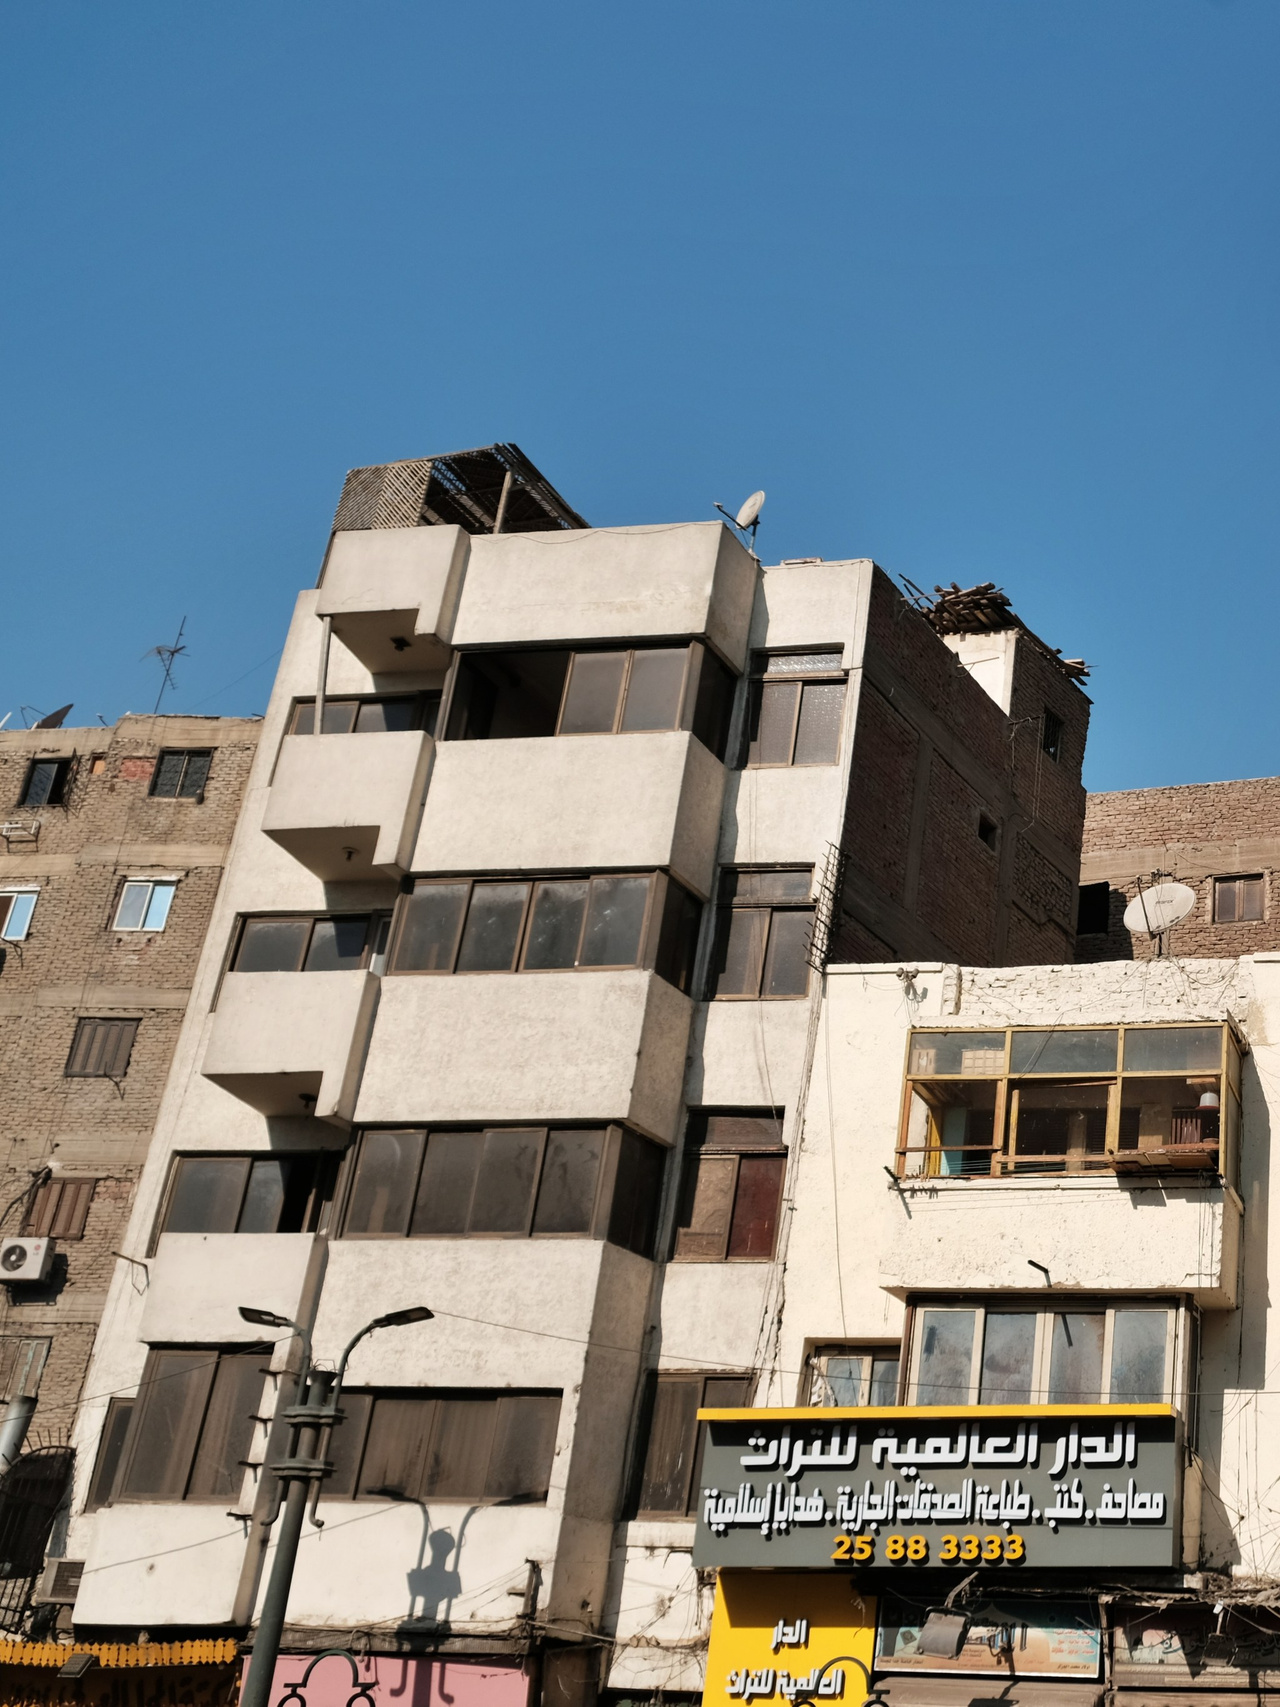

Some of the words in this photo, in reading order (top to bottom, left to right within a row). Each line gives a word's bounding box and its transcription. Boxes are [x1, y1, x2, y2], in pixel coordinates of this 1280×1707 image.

[740, 1425, 857, 1477] للتراث
[871, 1422, 1039, 1477] العالمية
[1047, 1421, 1136, 1475] الدار
[704, 1482, 774, 1535] إسلامية
[772, 1481, 824, 1530] هدايا
[836, 1480, 896, 1531] الجارية
[896, 1478, 973, 1520] الصدقات
[975, 1479, 1031, 1529] طباعة
[1044, 1478, 1084, 1528] كتب
[1096, 1478, 1164, 1519] مصاحف
[830, 1534, 873, 1560] 25
[885, 1534, 927, 1560] 88
[938, 1534, 1024, 1560] 3333
[771, 1619, 807, 1649] الدار
[725, 1668, 775, 1700] للتراث
